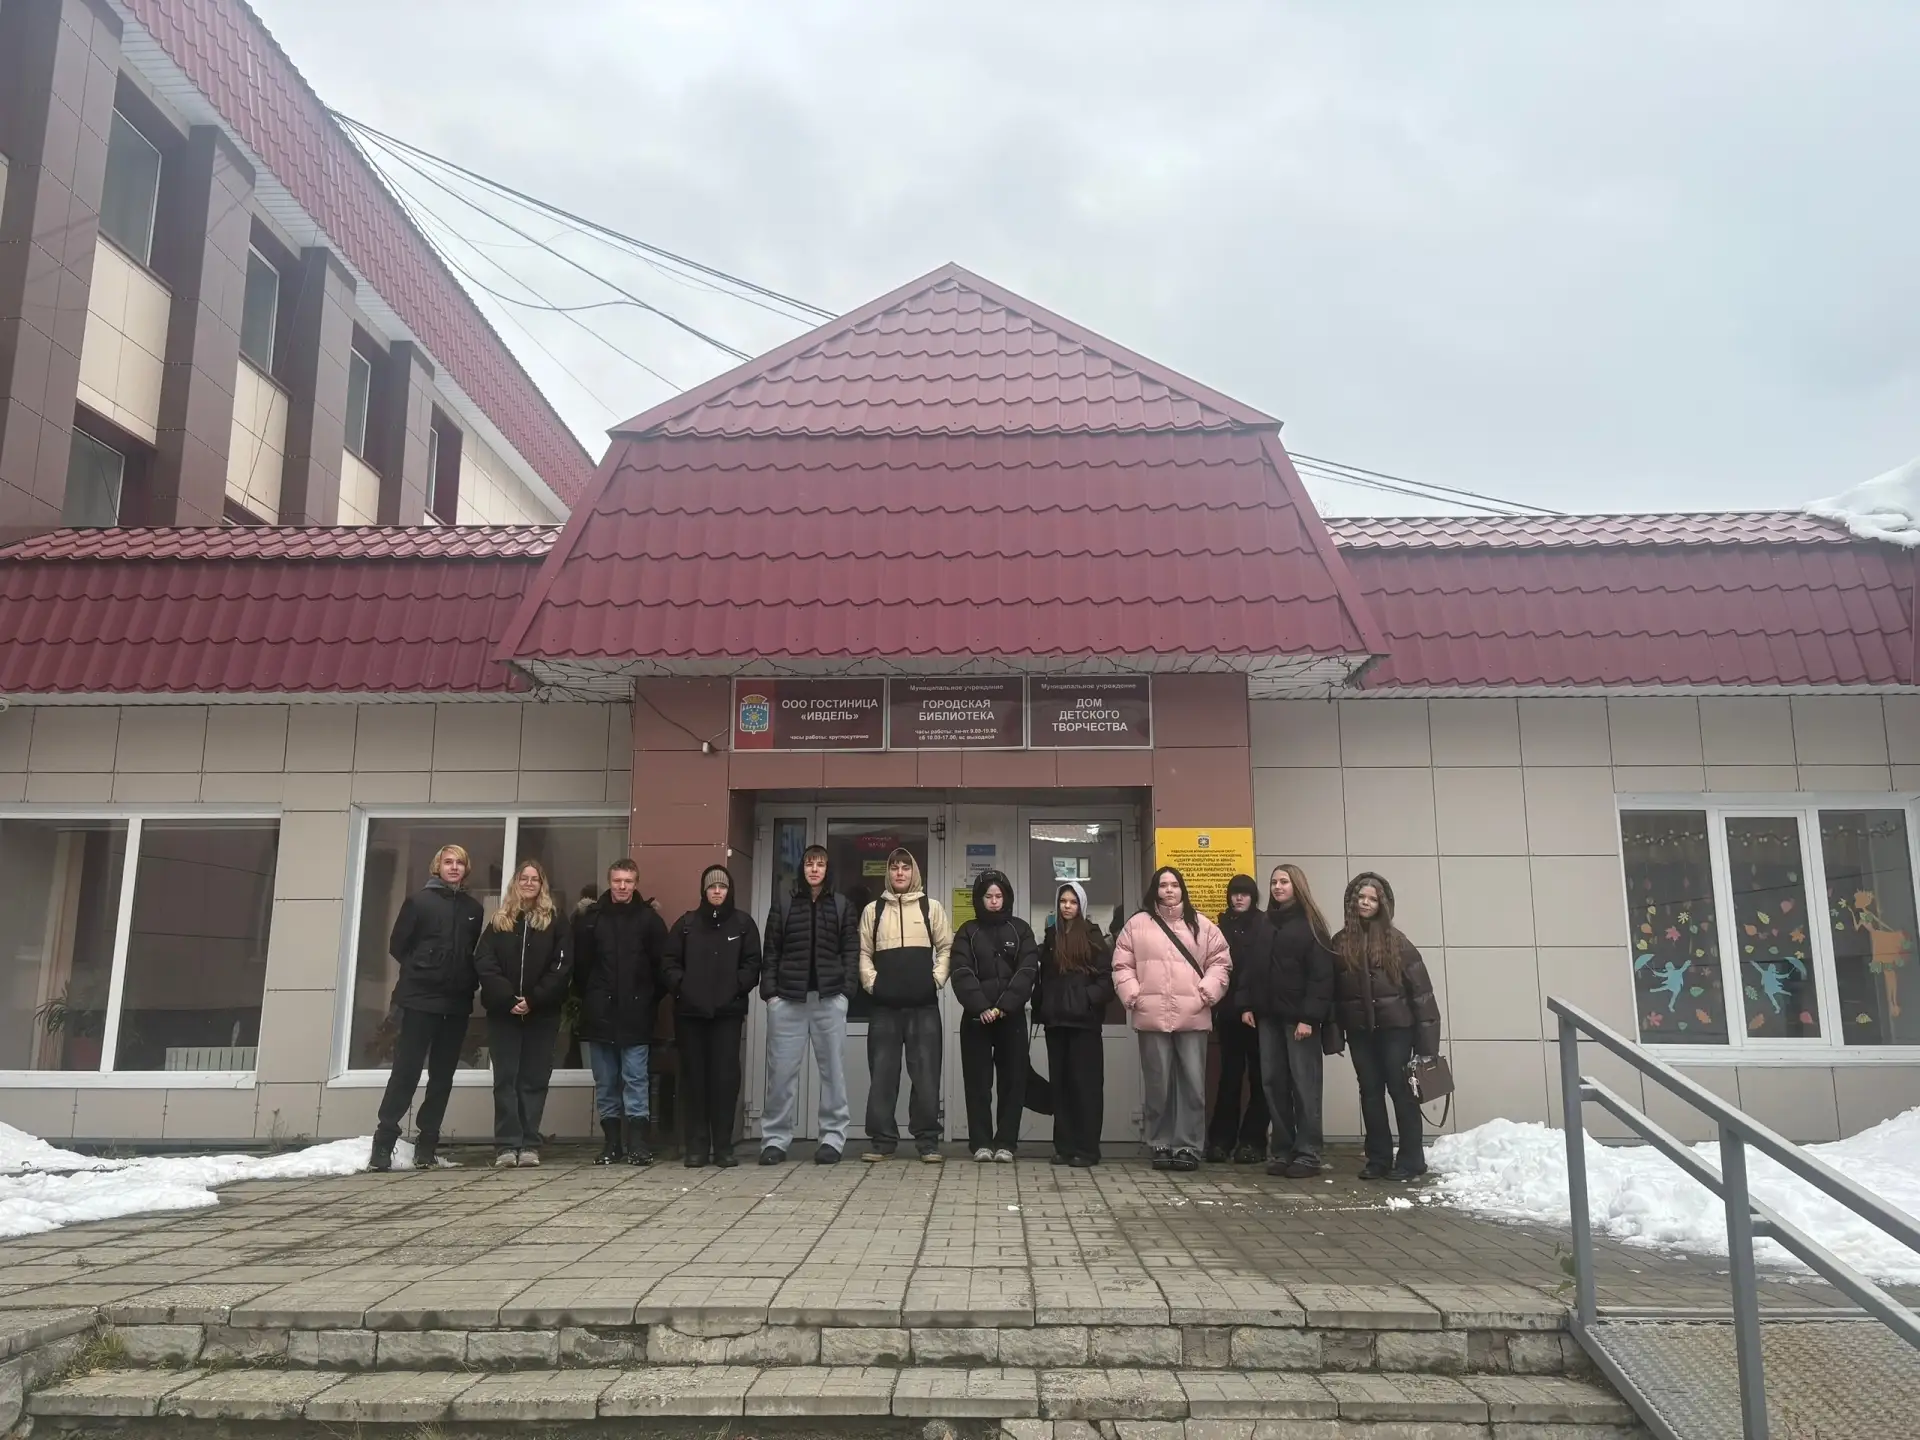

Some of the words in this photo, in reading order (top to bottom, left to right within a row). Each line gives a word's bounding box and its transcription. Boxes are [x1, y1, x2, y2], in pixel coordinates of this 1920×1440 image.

[964, 684, 1004, 692] учреждение
[1041, 683, 1095, 691] Муниципальное
[781, 699, 808, 709] ООО
[810, 698, 879, 710] ГОСТИНИЦА
[922, 699, 991, 710] ГОРОДСКАЯ
[1076, 698, 1102, 709] ДОМ
[801, 711, 859, 722] «ИВДЕЛЬ»
[919, 711, 995, 721] БИБЛИОТЕКА
[1059, 710, 1120, 721] ДЕТСКОГО
[1052, 722, 1128, 732] ТВОРЧЕСТВА
